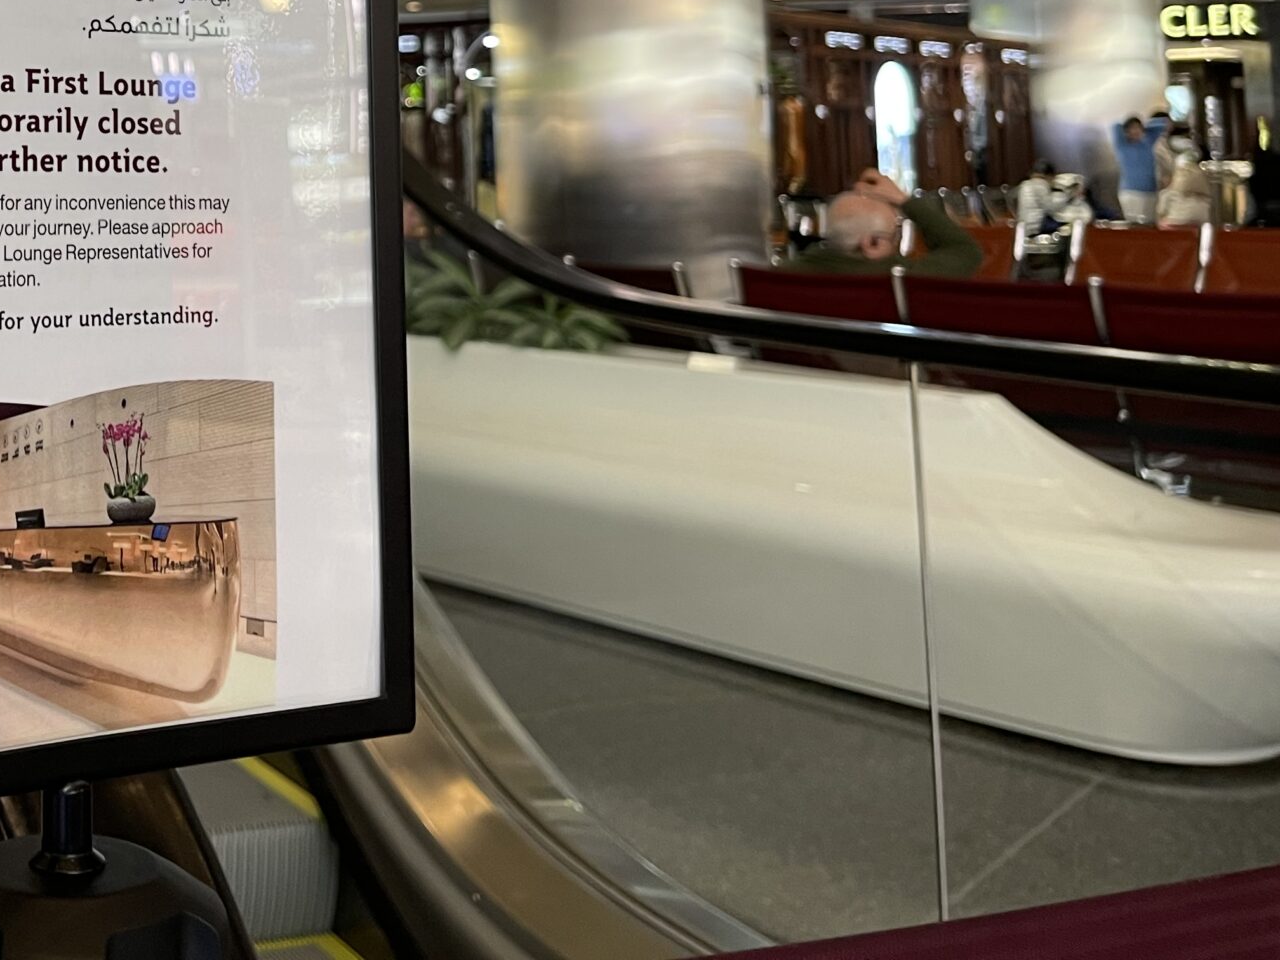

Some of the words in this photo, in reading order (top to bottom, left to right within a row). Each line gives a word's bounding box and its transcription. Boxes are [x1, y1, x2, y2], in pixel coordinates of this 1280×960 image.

[82, 15, 180, 39] لتفهمكم.
[1160, 3, 1261, 38] CLER
[25, 68, 88, 95] First
[99, 71, 195, 104] Lounge
[98, 108, 181, 135] closed
[77, 147, 168, 173] notice.
[0, 194, 21, 210] for
[24, 198, 52, 215] any
[56, 194, 165, 210] inconvenience
[169, 194, 195, 210] this
[199, 198, 230, 214] may
[33, 219, 93, 239] journey.
[98, 219, 148, 235] Please
[152, 218, 223, 238] approach
[4, 245, 62, 265] Lounge
[66, 243, 189, 264] Representatives
[192, 243, 213, 258] for
[30, 315, 72, 334] your
[80, 305, 218, 328] understanding.
